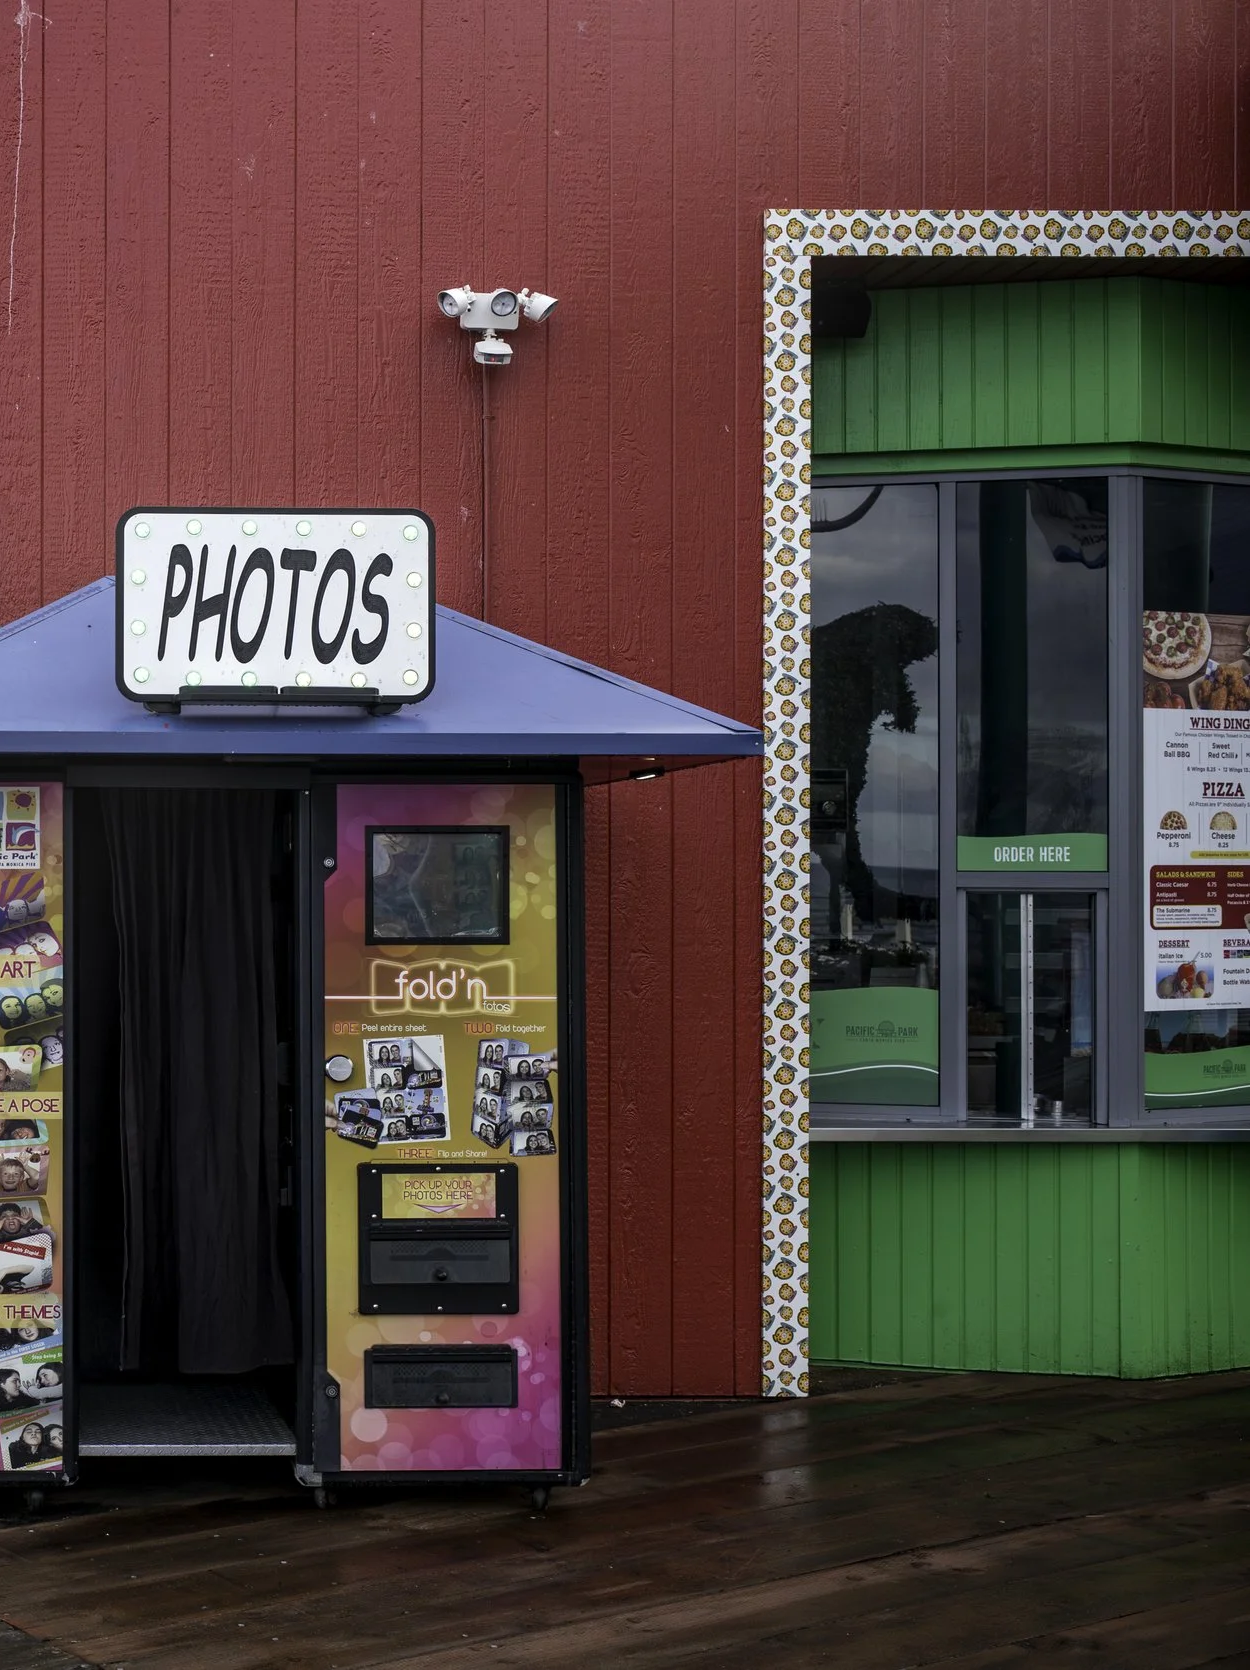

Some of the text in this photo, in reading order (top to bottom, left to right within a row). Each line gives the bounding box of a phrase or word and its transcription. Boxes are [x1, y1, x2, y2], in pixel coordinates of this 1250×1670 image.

[157, 543, 394, 665] PHOTOS
[1190, 717, 1221, 729] WING
[1212, 742, 1230, 750] Sweet
[1202, 782, 1245, 797] PIZZA
[1157, 832, 1191, 840] Pepperoni
[1211, 832, 1236, 840] Cheese
[12, 852, 36, 860] Park
[994, 846, 1071, 862] ORDER HERE
[1158, 940, 1190, 948] DESSERT
[0, 961, 36, 979] ART
[394, 968, 487, 1000] fold'n
[483, 1000, 511, 1012] fotos
[333, 1022, 427, 1035] ONE Peel entire sheet
[464, 1022, 547, 1034] TWO Fold together
[845, 1025, 918, 1037] PACIFIC PARK
[8, 1099, 19, 1113] A
[21, 1099, 60, 1113] POSE
[397, 1148, 434, 1159] THREE
[437, 1150, 450, 1158] Flip
[404, 1180, 472, 1190] PICK UP YOUR
[403, 1191, 473, 1200] PHOTOS HERE
[3, 1304, 61, 1320] THEMES
